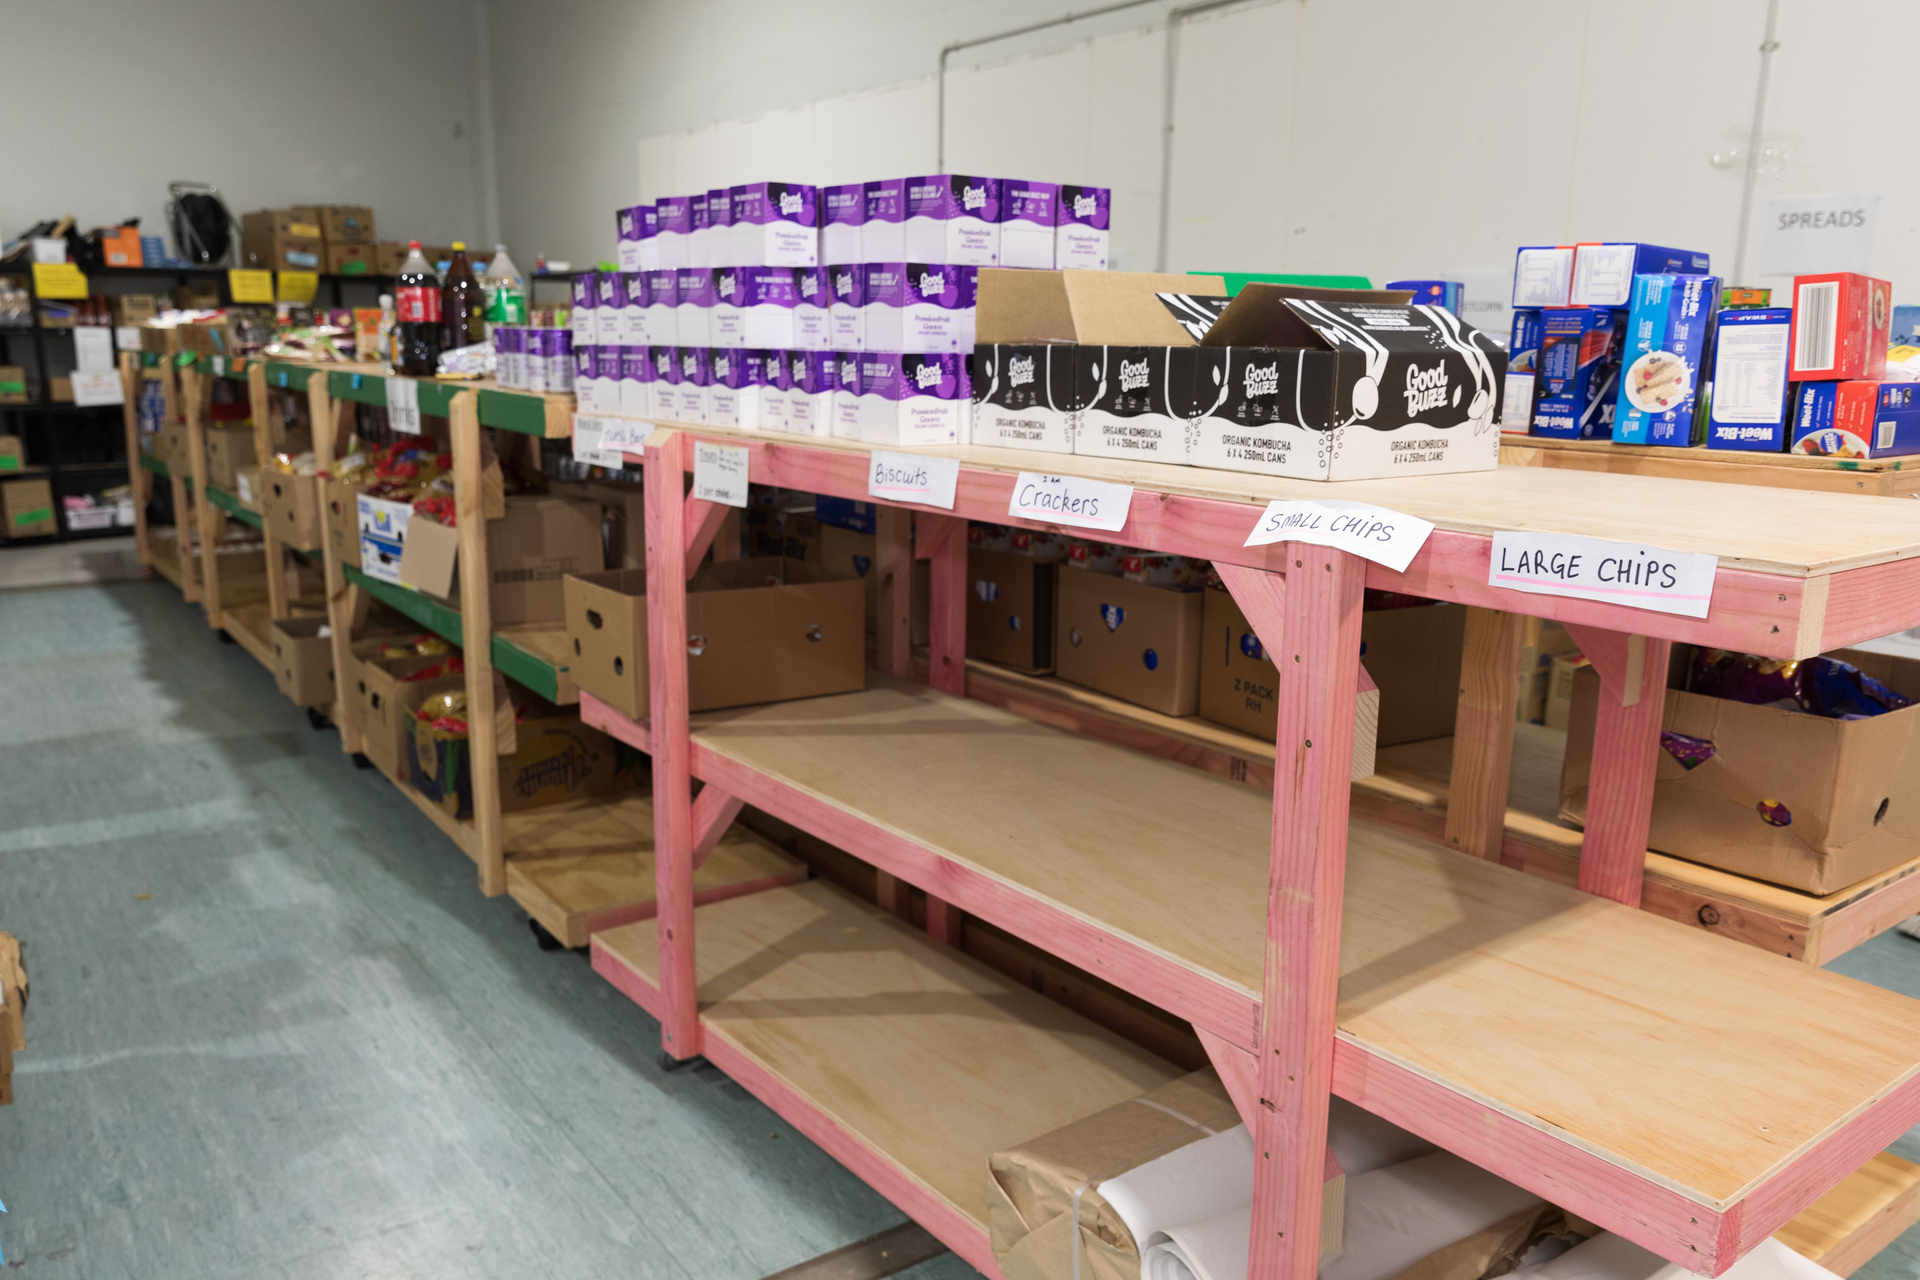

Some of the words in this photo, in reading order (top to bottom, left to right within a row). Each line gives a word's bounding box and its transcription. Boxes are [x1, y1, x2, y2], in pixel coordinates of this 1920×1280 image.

[1776, 208, 1866, 231] SPREADS
[916, 362, 942, 378] Good
[1009, 355, 1035, 374] Good
[1120, 357, 1150, 378] Good
[1245, 361, 1279, 382] Good
[1406, 359, 1449, 391] Good
[1801, 388, 1816, 427] Weet-Bix
[996, 418, 1017, 428] ORGANIC
[1018, 419, 1046, 430] KOMBUCHA
[1533, 415, 1574, 429] Weet-Bix
[1029, 432, 1042, 441] CANS
[1102, 426, 1127, 436] ORGANIC
[1129, 428, 1162, 439] KOMBUCHA
[1715, 427, 1773, 441] Weet-Bix
[1122, 439, 1140, 449] 250mL
[1141, 440, 1158, 450] CANS
[1222, 435, 1252, 447] ORGANIC
[1253, 438, 1291, 451] KOMBUCHA
[1391, 441, 1416, 451] ORGANIC
[1418, 439, 1449, 450] KOMBUCHA
[1244, 450, 1265, 461] 250mL
[1267, 453, 1286, 464] CANS
[1409, 453, 1427, 462] 250mL
[1428, 452, 1443, 461] CANS
[875, 463, 928, 486] Biscuits
[1019, 484, 1099, 516] Crackers
[1266, 513, 1322, 532] SMALL
[1501, 547, 1582, 580] LARGE
[1244, 681, 1274, 701] PACK
